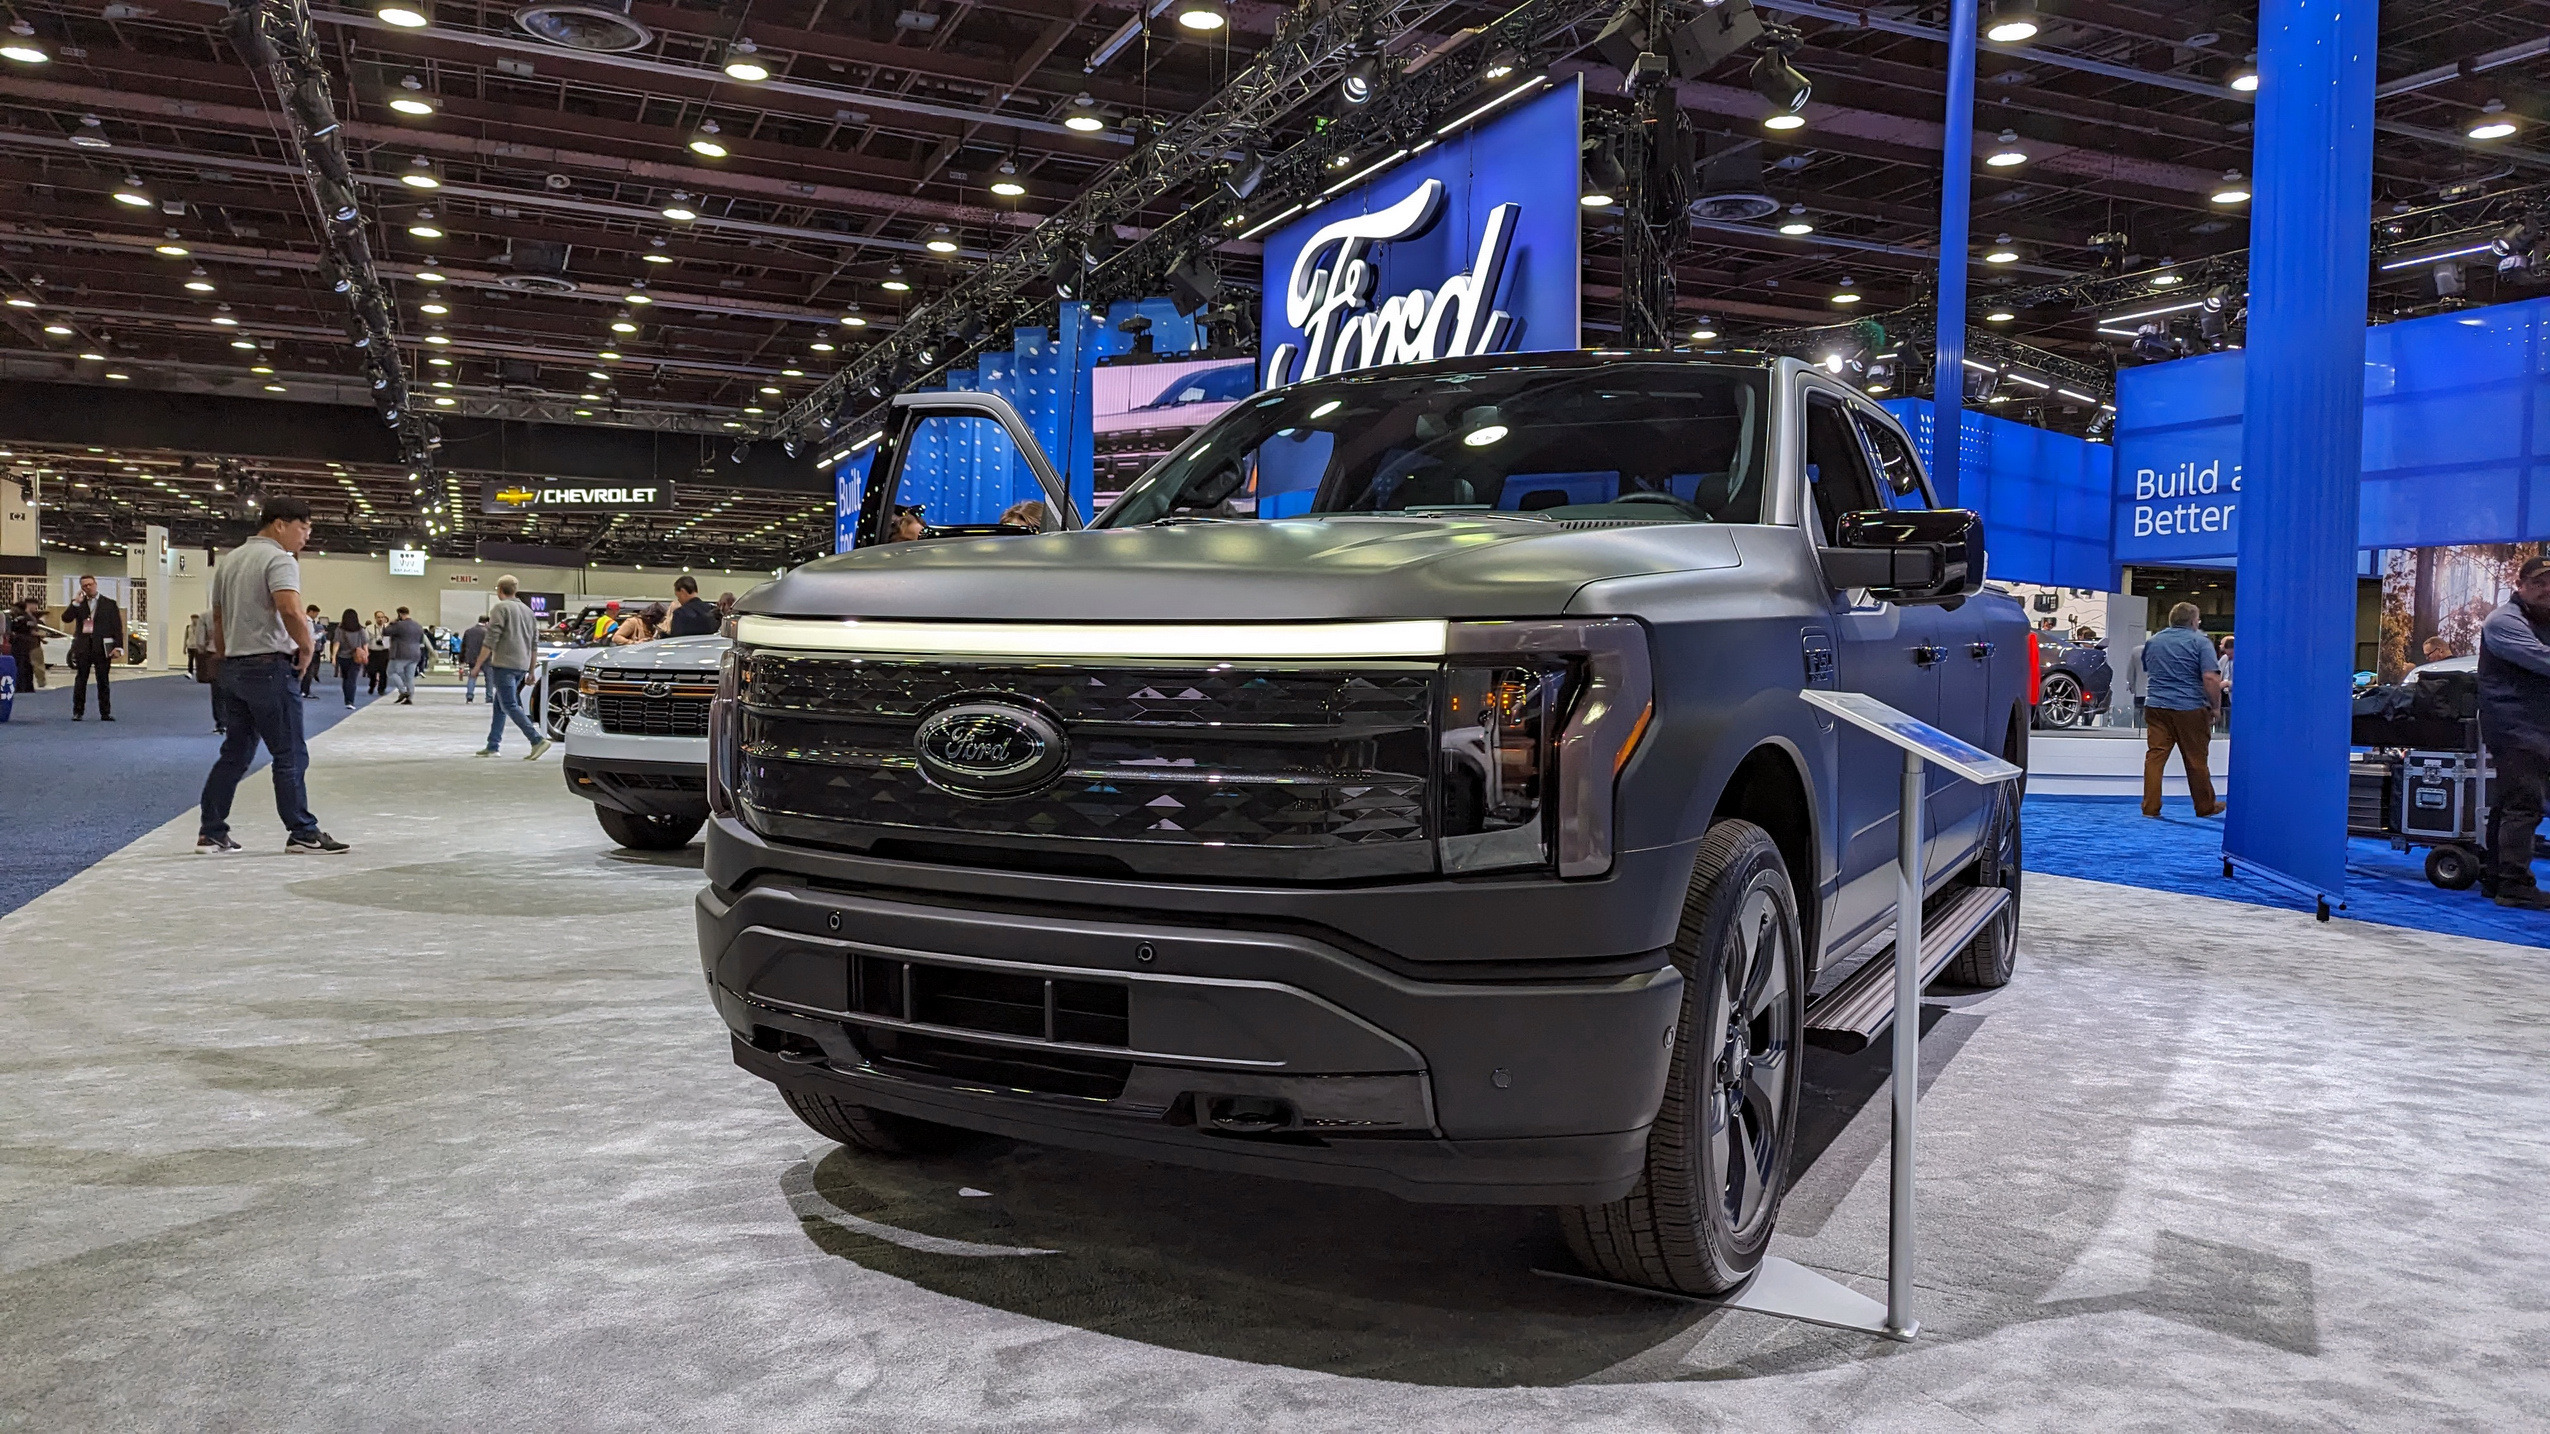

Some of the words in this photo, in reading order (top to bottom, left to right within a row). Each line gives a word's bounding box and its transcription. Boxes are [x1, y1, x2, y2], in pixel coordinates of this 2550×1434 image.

[1266, 178, 1518, 390] Ford
[543, 487, 658, 504] CHEVROLET
[838, 467, 862, 518] Built
[2136, 459, 2219, 501] Build
[2133, 502, 2236, 538] Better
[840, 523, 854, 554] for
[944, 726, 1013, 762] Ford
